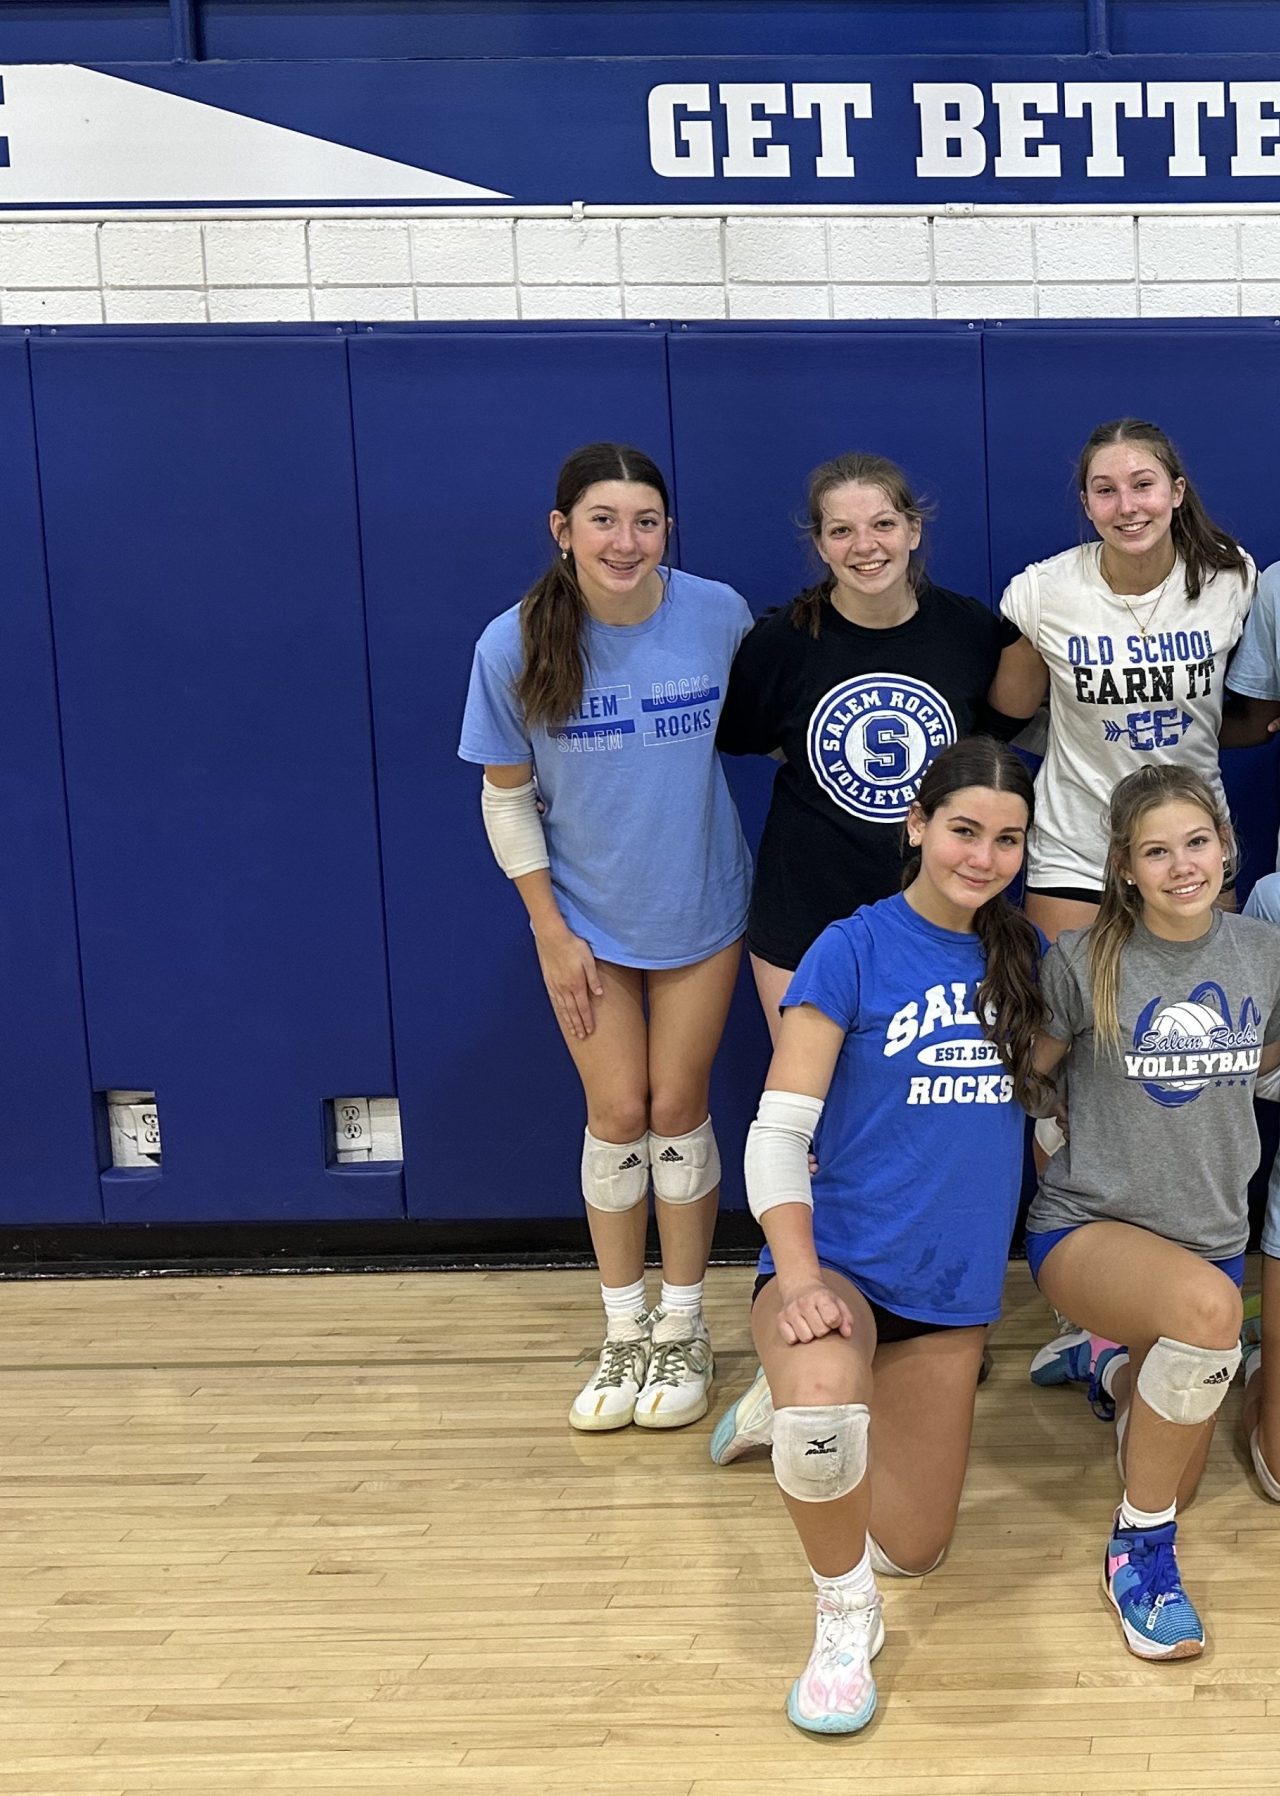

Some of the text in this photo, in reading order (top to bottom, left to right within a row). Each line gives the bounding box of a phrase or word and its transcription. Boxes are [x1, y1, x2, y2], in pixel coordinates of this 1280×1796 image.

[648, 83, 872, 177] GET
[1068, 630, 1216, 666] OLD SCHOOL
[651, 674, 712, 706] ROCKS
[1073, 659, 1215, 705] EARN IT
[655, 709, 711, 738] ROCKS
[823, 690, 945, 751] SALEM ROCKS
[1127, 707, 1179, 751] CC
[556, 728, 624, 753] SALEM
[862, 715, 910, 781] S
[935, 1047, 967, 1062] EST.
[1138, 1023, 1258, 1053] Salem Rocks
[906, 1075, 1015, 1105] ROCKS
